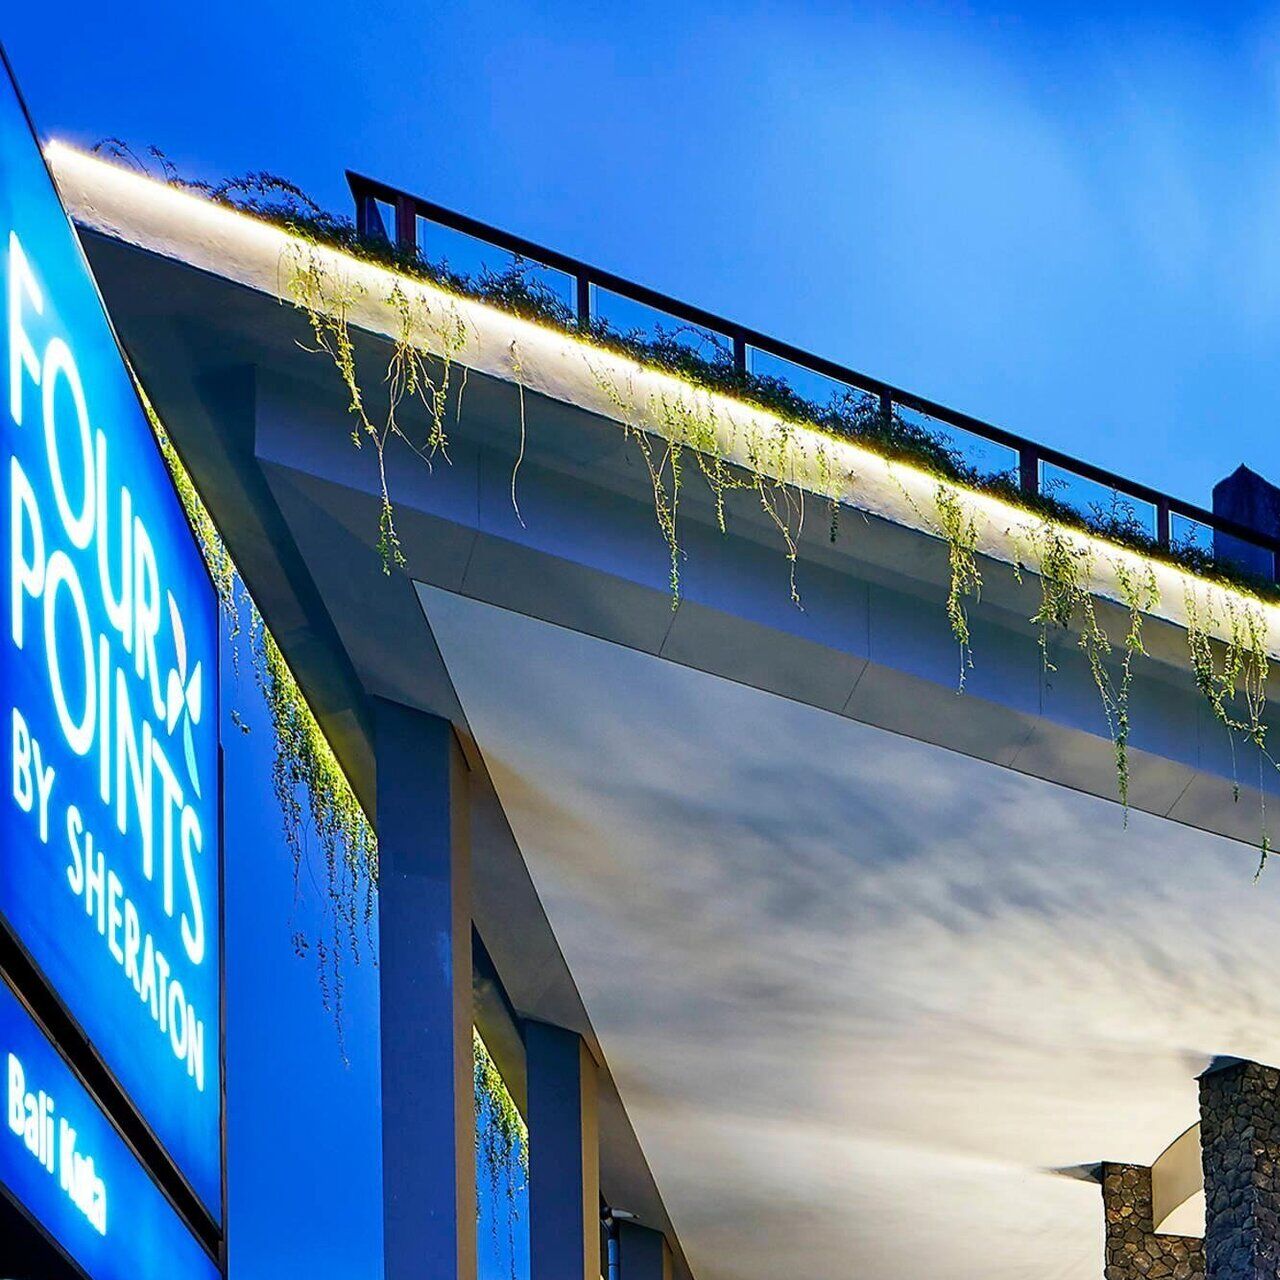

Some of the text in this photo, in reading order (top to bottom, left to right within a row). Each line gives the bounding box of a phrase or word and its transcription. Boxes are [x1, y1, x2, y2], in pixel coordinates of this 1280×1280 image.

[11, 229, 166, 721] FOUR
[11, 455, 205, 965] POINTS
[12, 706, 205, 1092] BY SHERATON
[8, 1052, 107, 1237] Bali Kuta
